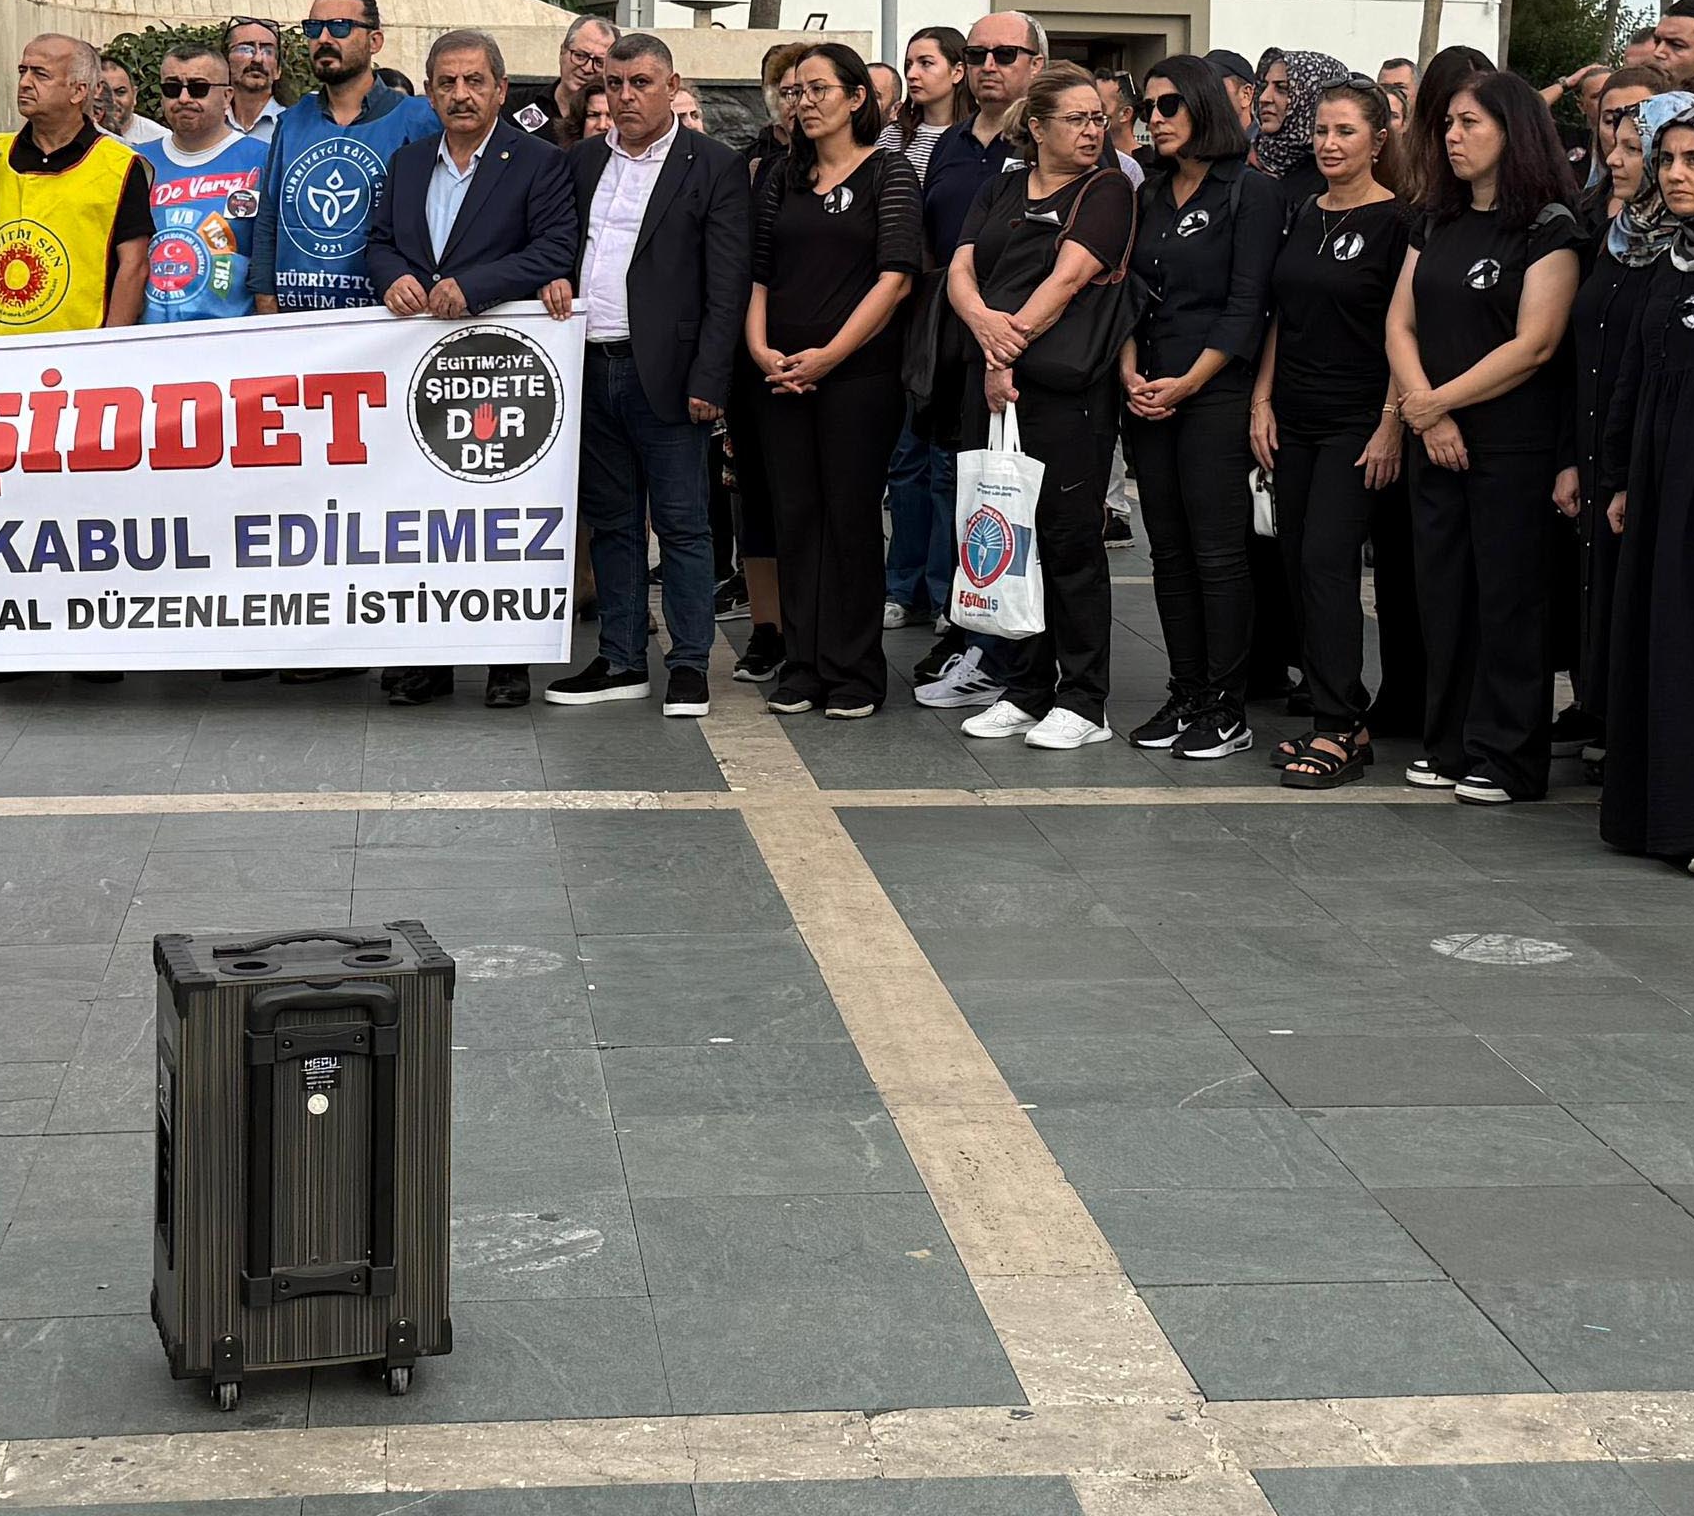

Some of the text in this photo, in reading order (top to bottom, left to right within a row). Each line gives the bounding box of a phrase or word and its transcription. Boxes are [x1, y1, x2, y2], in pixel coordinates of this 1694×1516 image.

[286, 141, 338, 203] HÜRRİYETÇİ
[343, 144, 379, 177] EĞİTİM
[155, 183, 184, 204] De
[314, 242, 343, 253] 2021
[213, 260, 231, 291] THS
[275, 268, 375, 295] HÜRRİYETÇ
[277, 290, 337, 309] EĞİTİM
[461, 443, 505, 469] DE
[234, 499, 565, 568] EDİLEMEZ
[67, 590, 331, 631] DÜZENLEME
[346, 582, 567, 625] İSTİYORUZ
